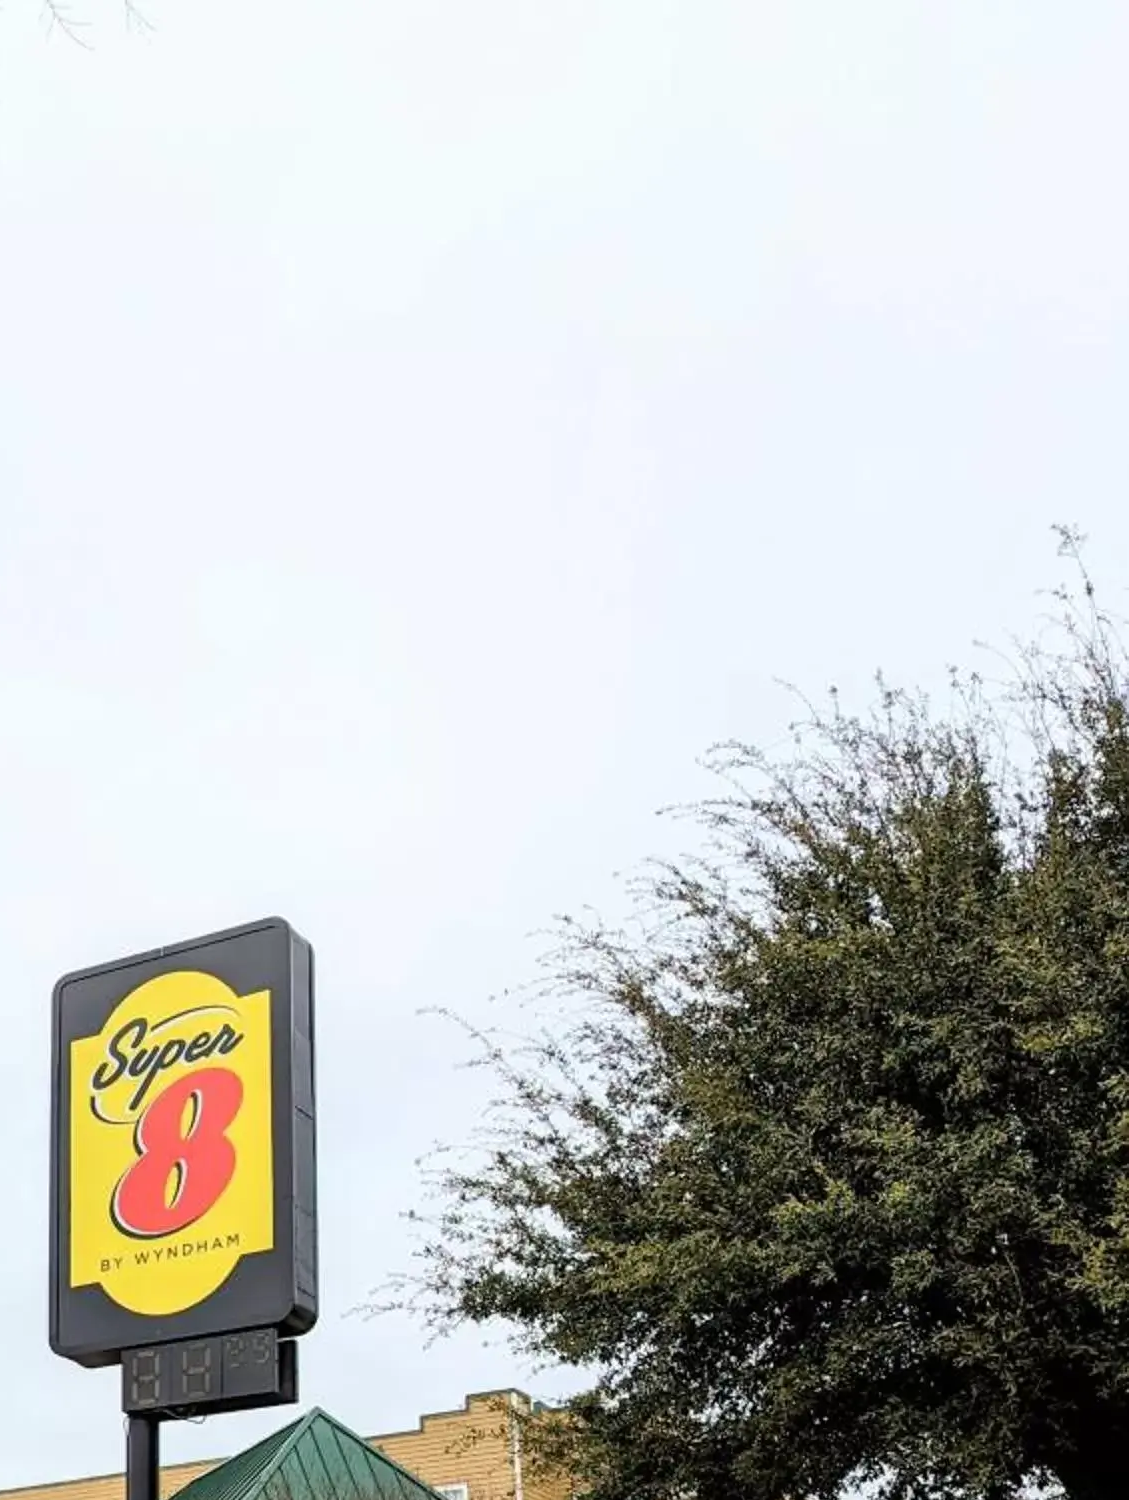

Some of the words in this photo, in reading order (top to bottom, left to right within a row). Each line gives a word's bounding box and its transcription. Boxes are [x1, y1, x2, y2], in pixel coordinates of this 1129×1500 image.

[92, 1017, 244, 1110] Super
[109, 1067, 244, 1240] 8
[100, 1257, 123, 1273] BY
[134, 1233, 240, 1266] WYNDHAM
